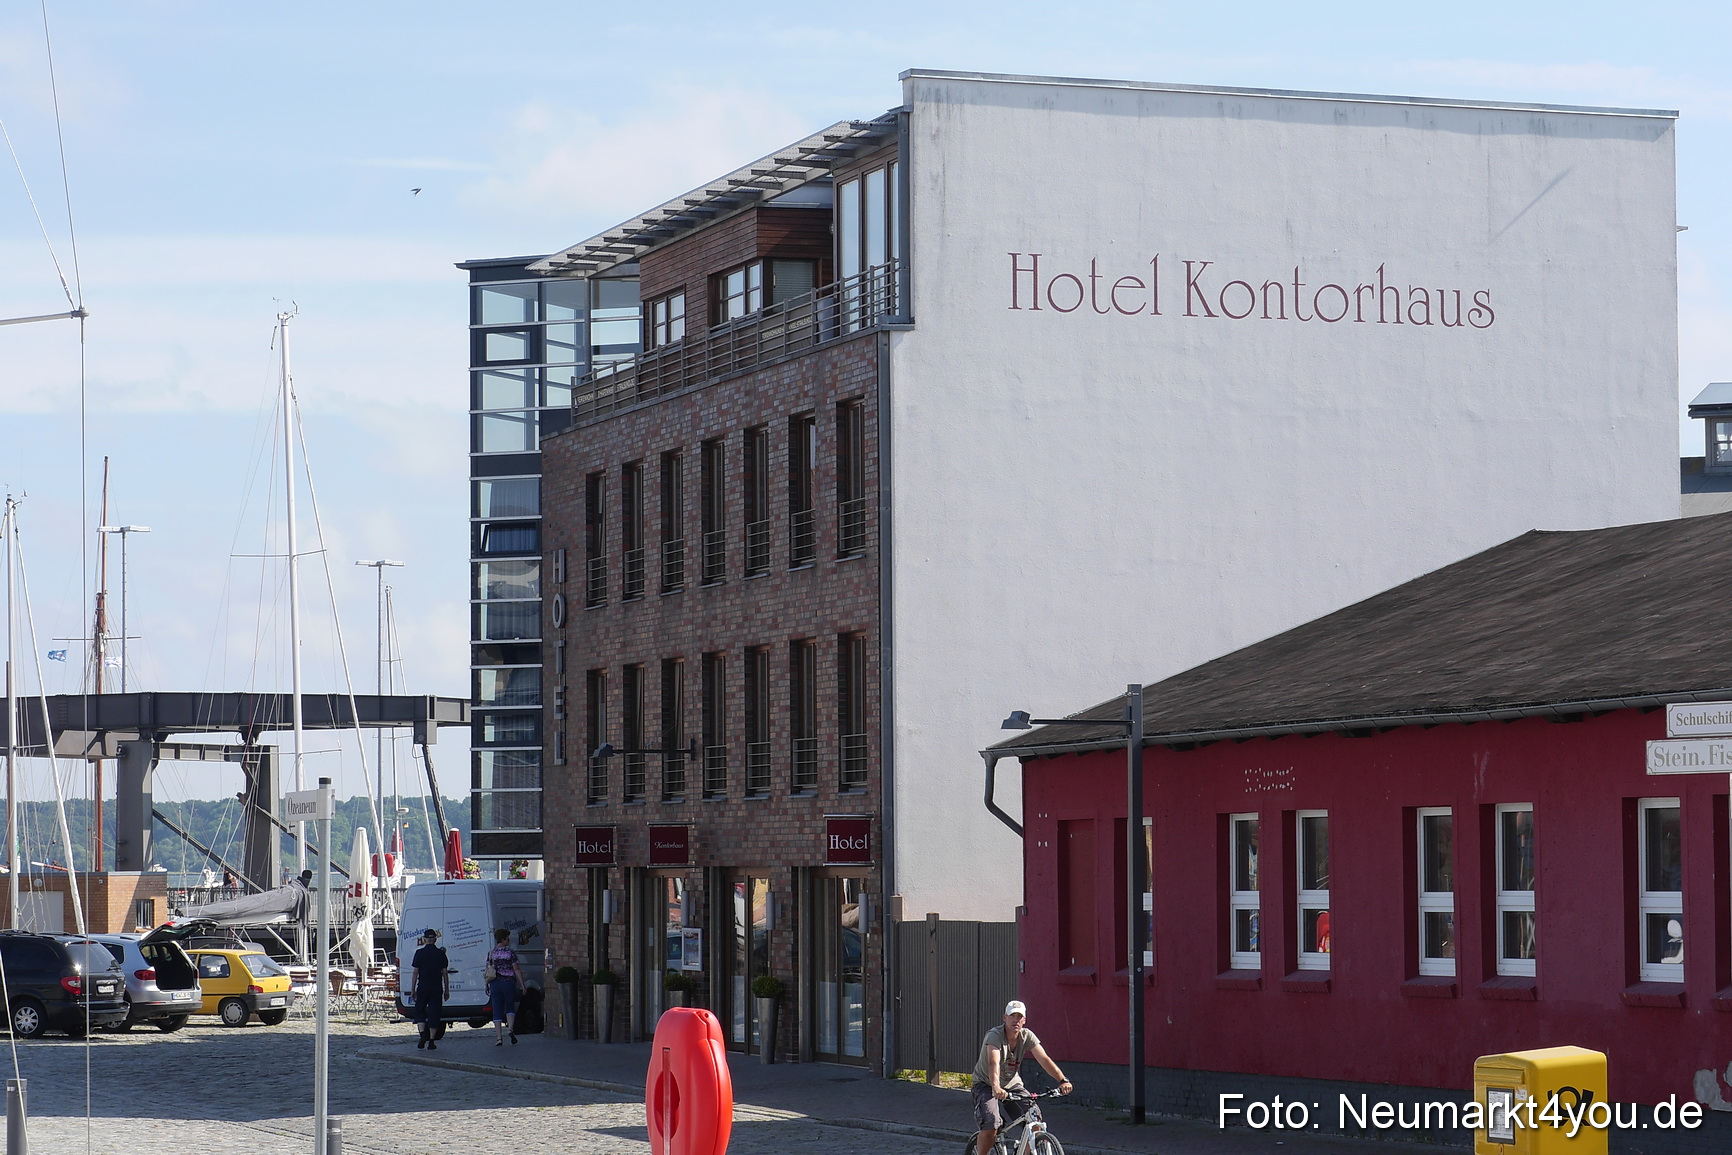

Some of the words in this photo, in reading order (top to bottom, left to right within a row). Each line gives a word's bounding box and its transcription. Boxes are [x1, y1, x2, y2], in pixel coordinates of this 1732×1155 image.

[1007, 252, 1163, 316] Hotel
[1182, 259, 1496, 330] Kontorhaus
[553, 549, 565, 766] HOTEL
[287, 797, 317, 815] Ozeaneum
[577, 840, 611, 853] Hotel
[829, 833, 868, 850] Hotel
